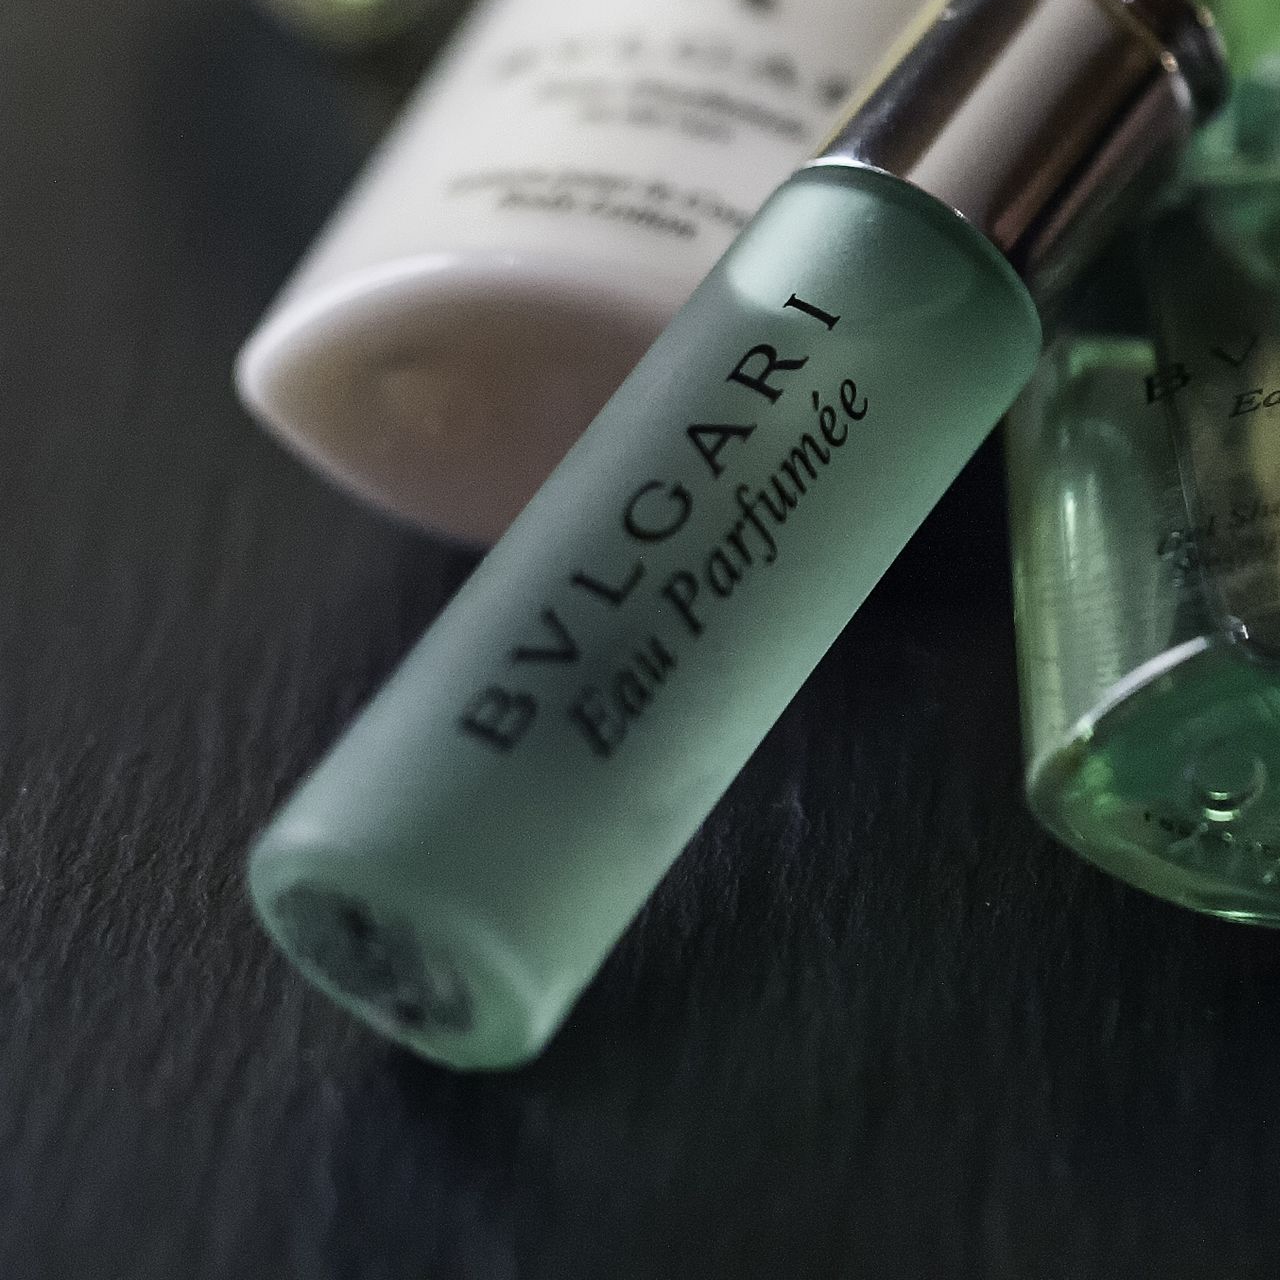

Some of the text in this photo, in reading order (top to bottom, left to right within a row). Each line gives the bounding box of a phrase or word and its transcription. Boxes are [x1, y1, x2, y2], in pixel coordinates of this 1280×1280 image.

[459, 292, 842, 754] BVLGARI
[566, 377, 870, 761] Eau Parfumée
